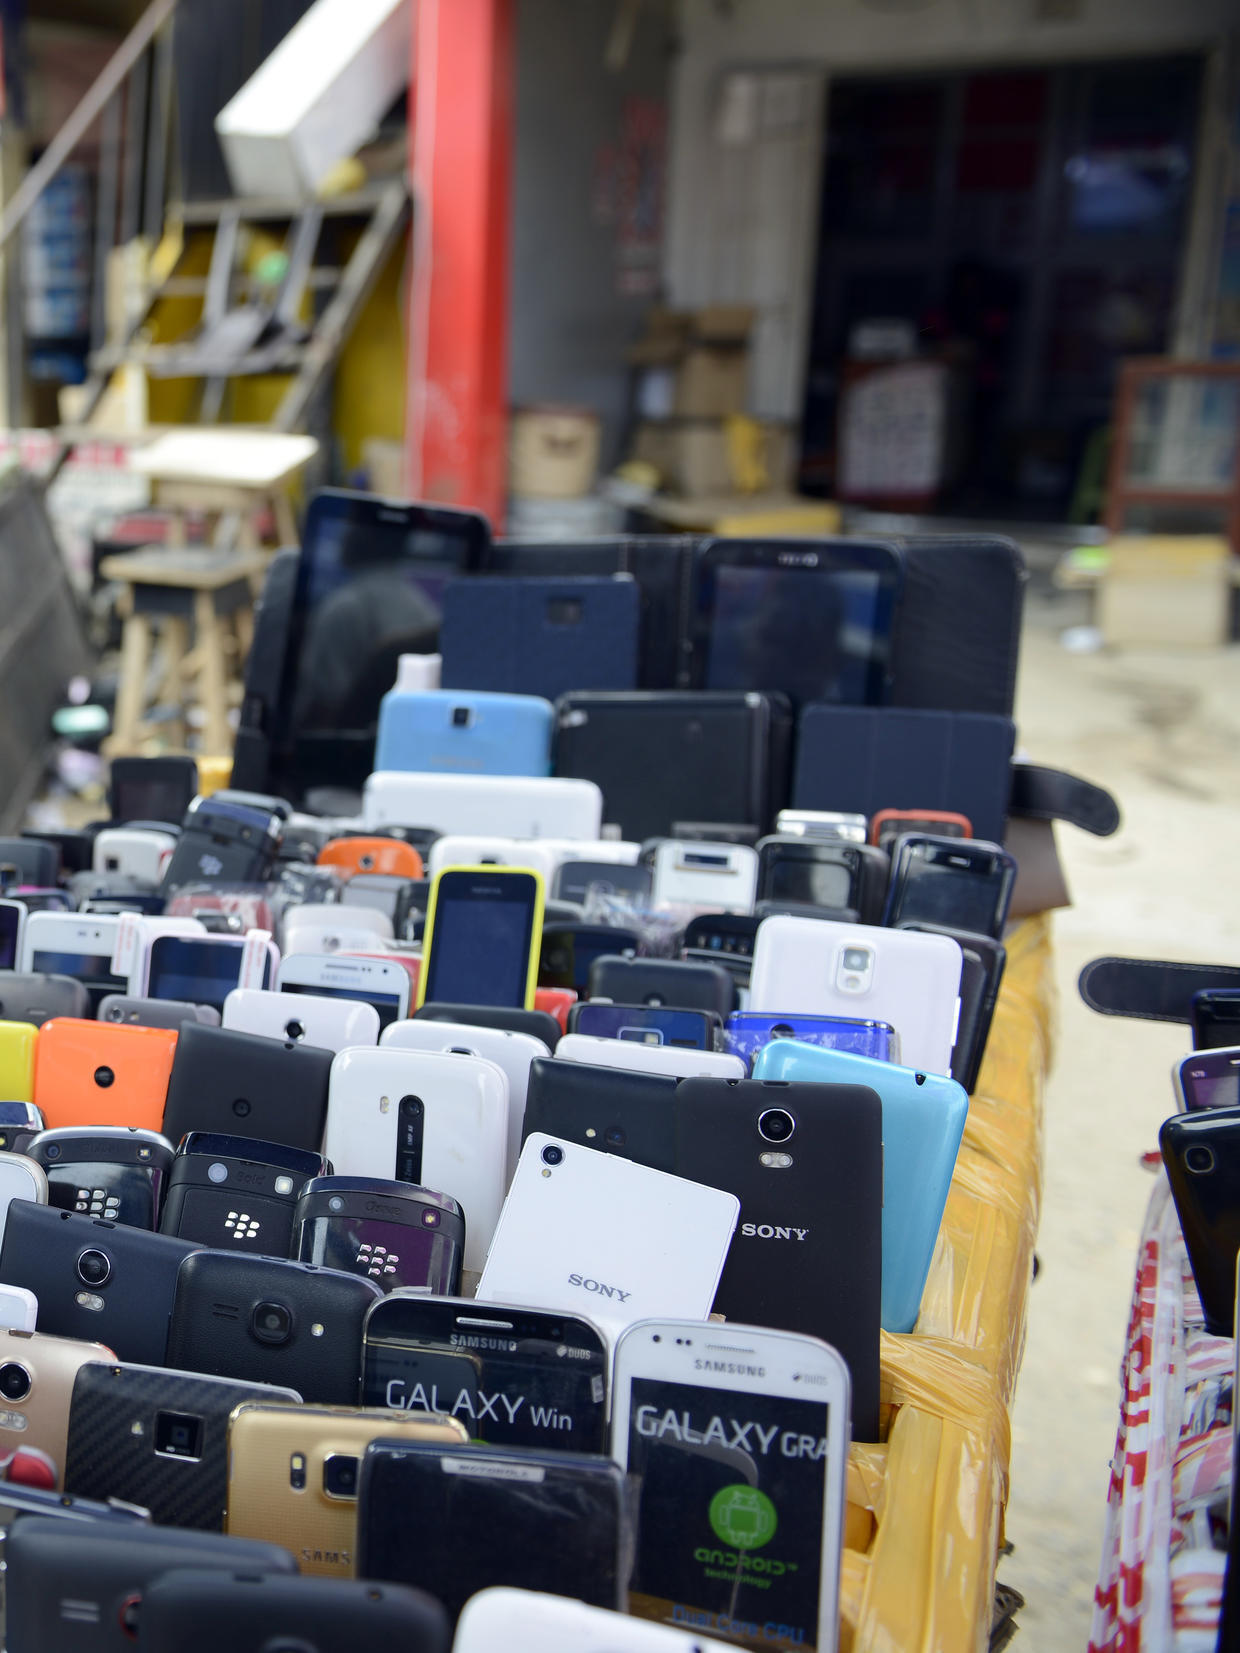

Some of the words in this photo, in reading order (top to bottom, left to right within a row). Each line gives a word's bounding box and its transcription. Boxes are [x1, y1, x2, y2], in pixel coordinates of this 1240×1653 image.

[741, 1223, 808, 1241] SONY
[568, 1273, 631, 1303] SONY
[450, 1334, 517, 1352] SAMSUNG
[568, 1347, 592, 1360] DUOS
[694, 1358, 766, 1378] SAMSUNG
[386, 1379, 525, 1424] GALAXY
[530, 1405, 573, 1431] Win
[635, 1404, 780, 1456] GALAXY
[704, 1567, 772, 1590] technology
[672, 1604, 713, 1627] Dual
[717, 1612, 758, 1637] Core
[763, 1621, 805, 1645] CPU
